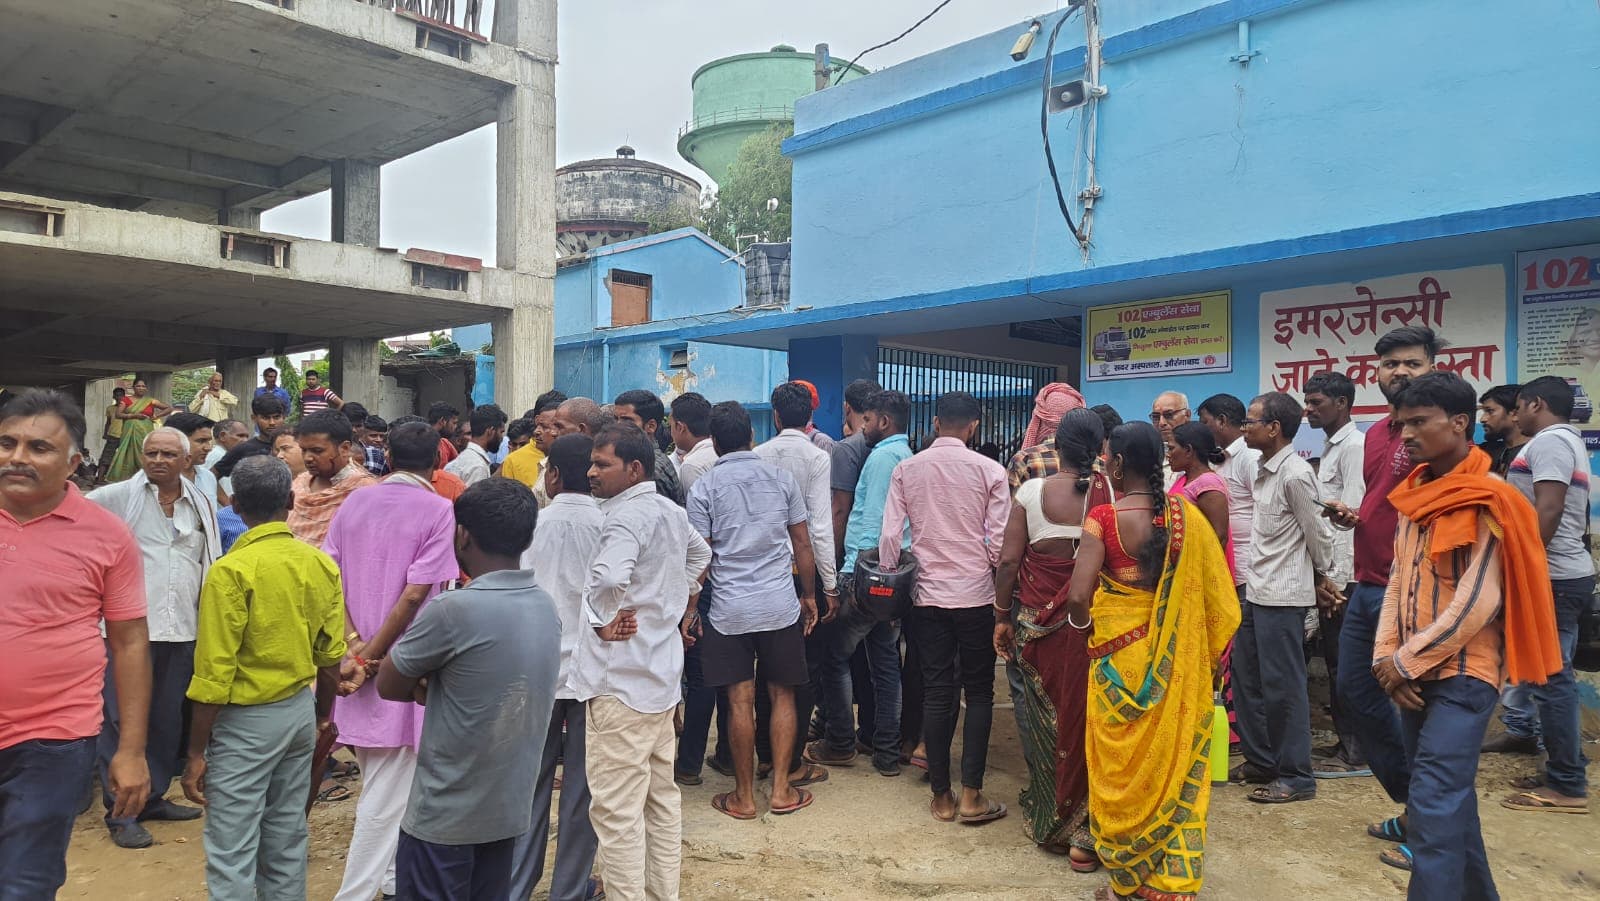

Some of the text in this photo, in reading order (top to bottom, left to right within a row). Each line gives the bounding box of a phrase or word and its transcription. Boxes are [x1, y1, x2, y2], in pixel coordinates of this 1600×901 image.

[1523, 256, 1592, 291] 102
[1117, 309, 1140, 323] 102
[1180, 303, 1201, 314] सेवा
[1273, 276, 1452, 351] इमरजेन्सी
[1128, 326, 1147, 340] 102
[1183, 335, 1199, 346] सेवा
[1345, 354, 1381, 390] क
